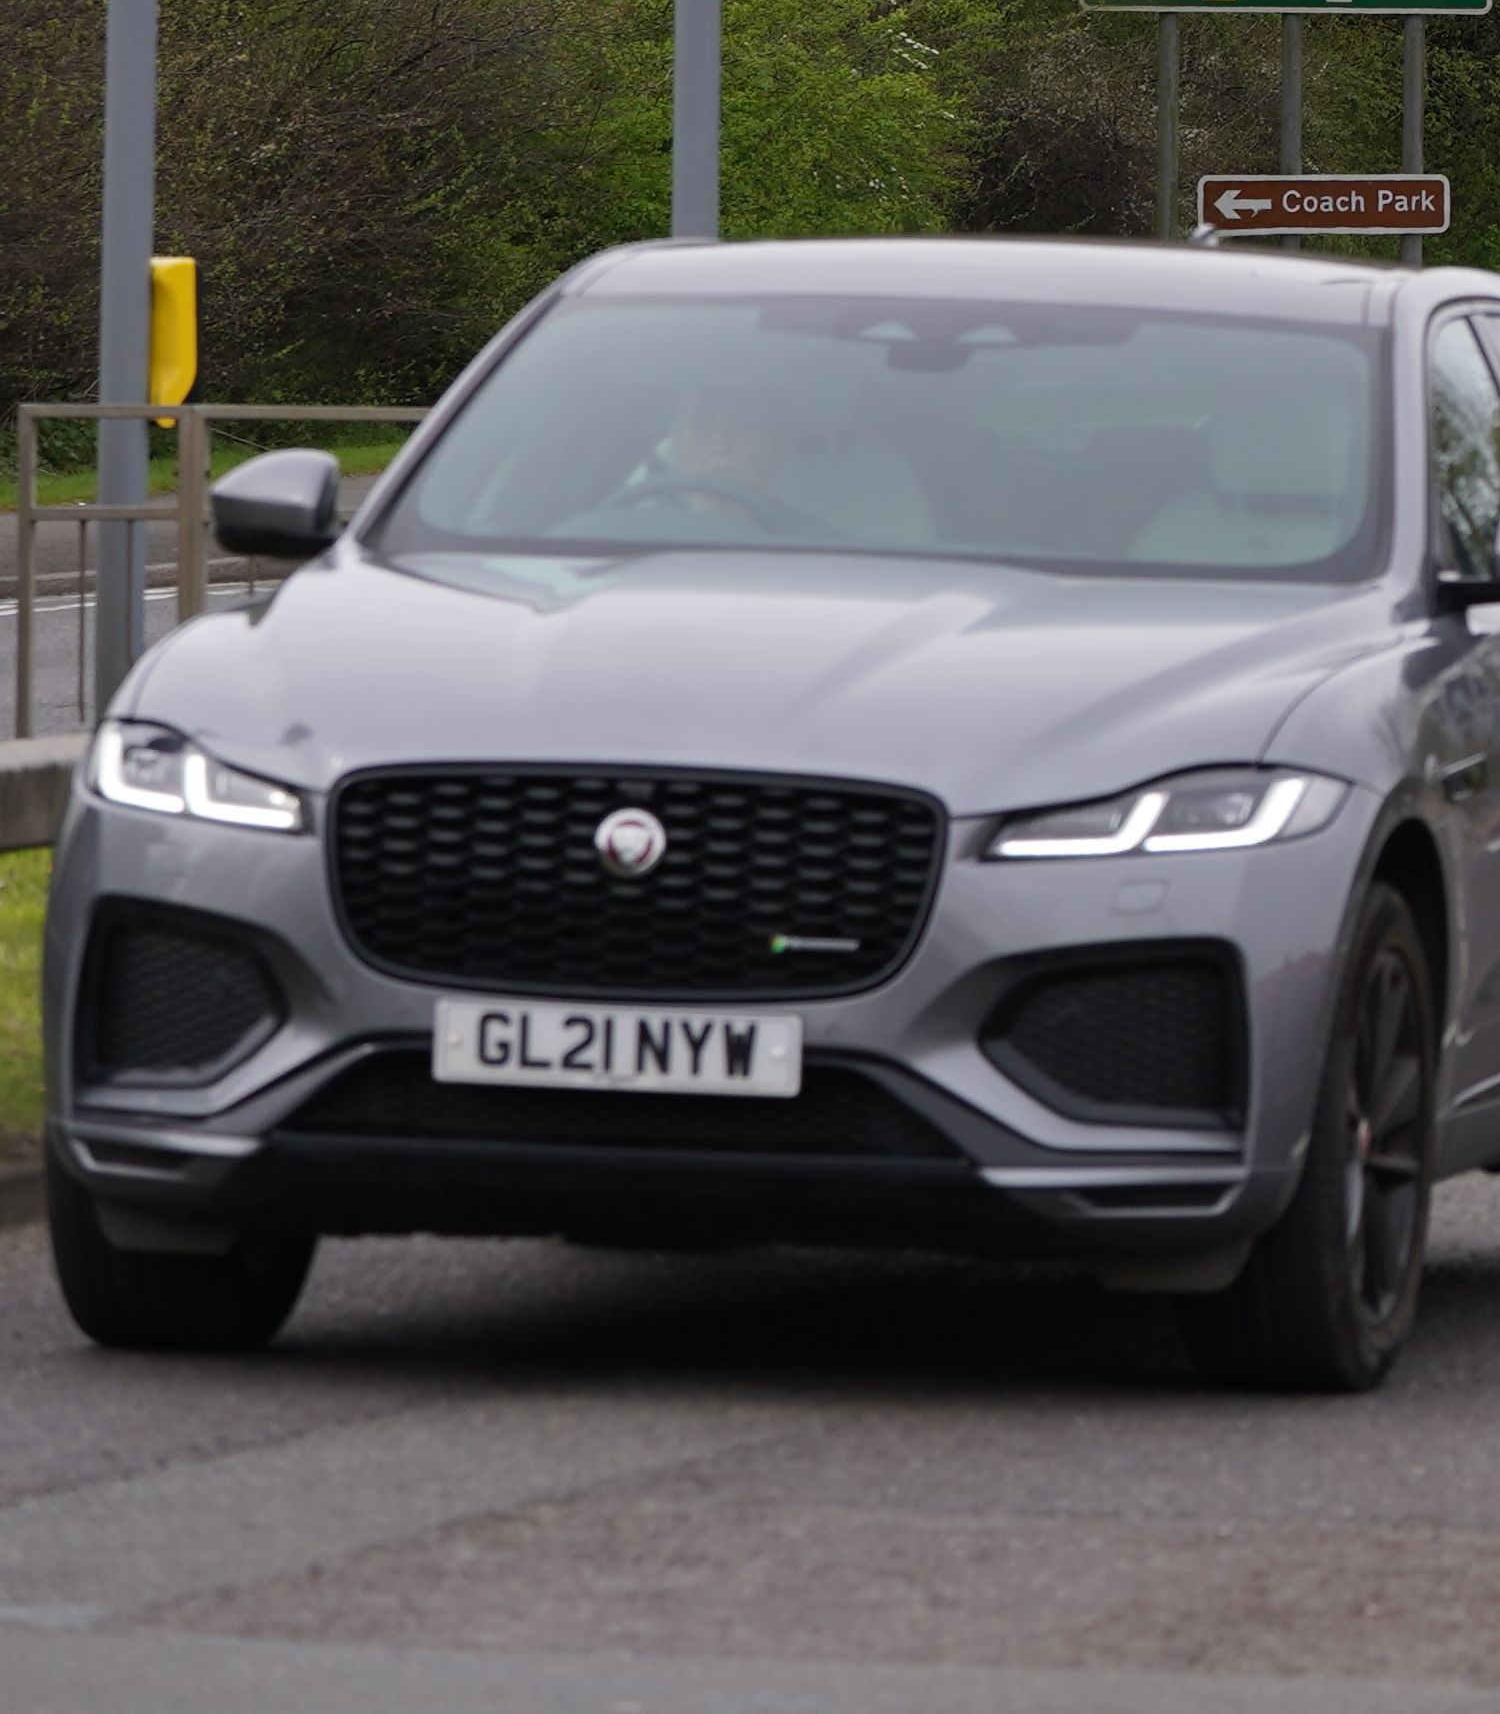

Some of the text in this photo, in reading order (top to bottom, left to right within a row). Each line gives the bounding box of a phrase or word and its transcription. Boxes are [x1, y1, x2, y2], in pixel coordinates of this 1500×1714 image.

[1282, 189, 1437, 213] Coach Park
[477, 1012, 758, 1078] GL21 NYW
